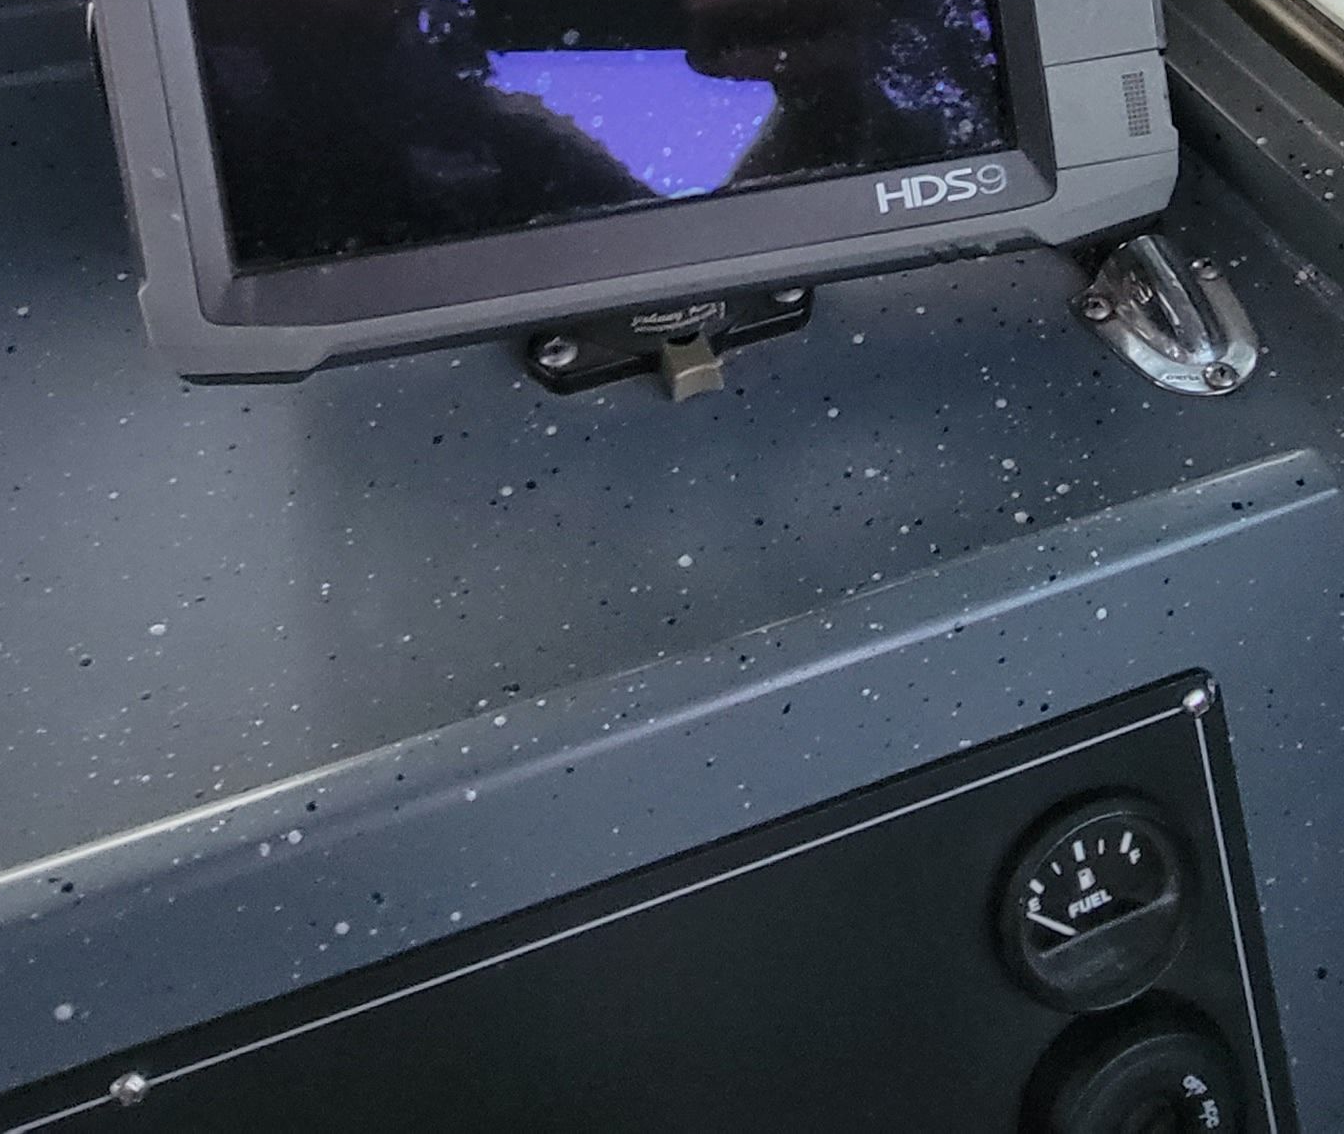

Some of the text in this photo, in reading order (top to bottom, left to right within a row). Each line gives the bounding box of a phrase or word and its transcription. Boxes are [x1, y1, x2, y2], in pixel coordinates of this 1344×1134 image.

[874, 163, 1007, 214] HDS9
[1129, 847, 1142, 865] F
[1027, 896, 1042, 913] E
[1067, 889, 1113, 919] FUEL
